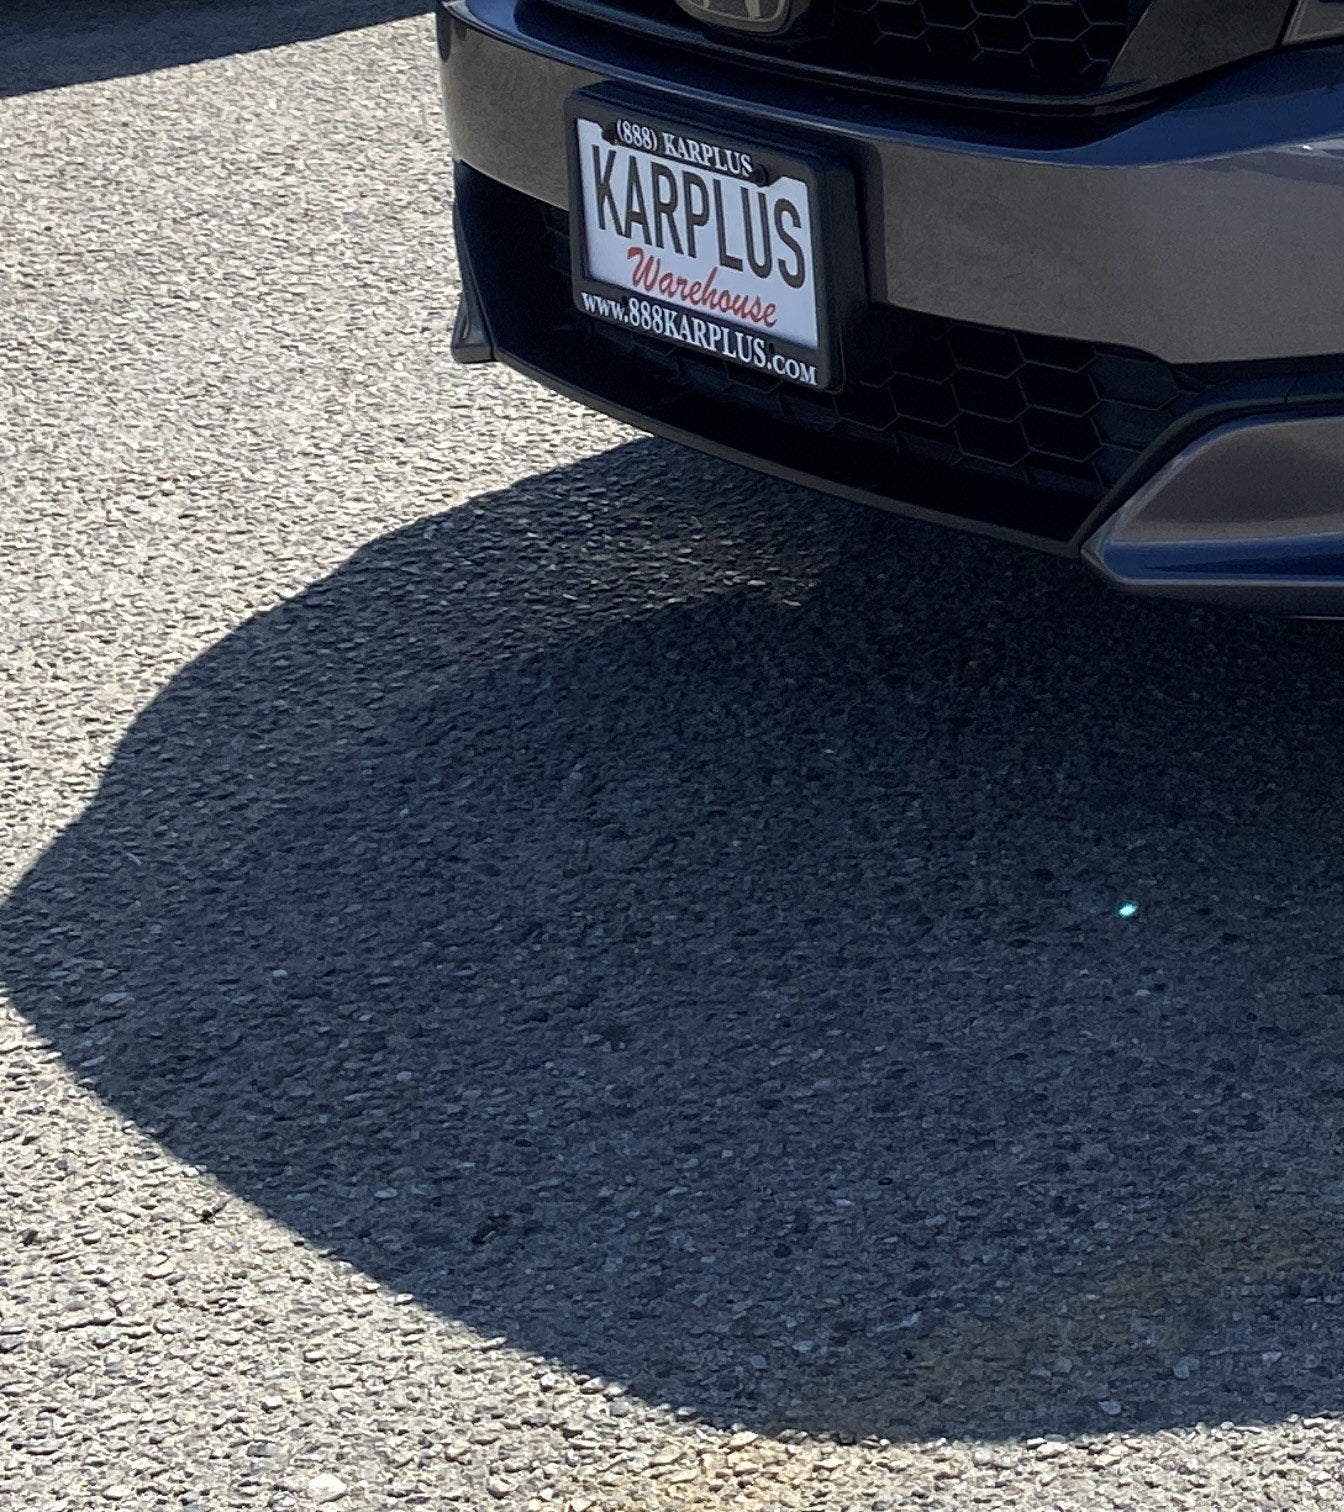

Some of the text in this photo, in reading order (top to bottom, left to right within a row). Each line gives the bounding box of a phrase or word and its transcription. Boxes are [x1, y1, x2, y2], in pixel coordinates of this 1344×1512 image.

[616, 118, 753, 175] (888) KARPLUS
[592, 144, 806, 289] KARPLUS
[627, 246, 778, 328] Warehouse
